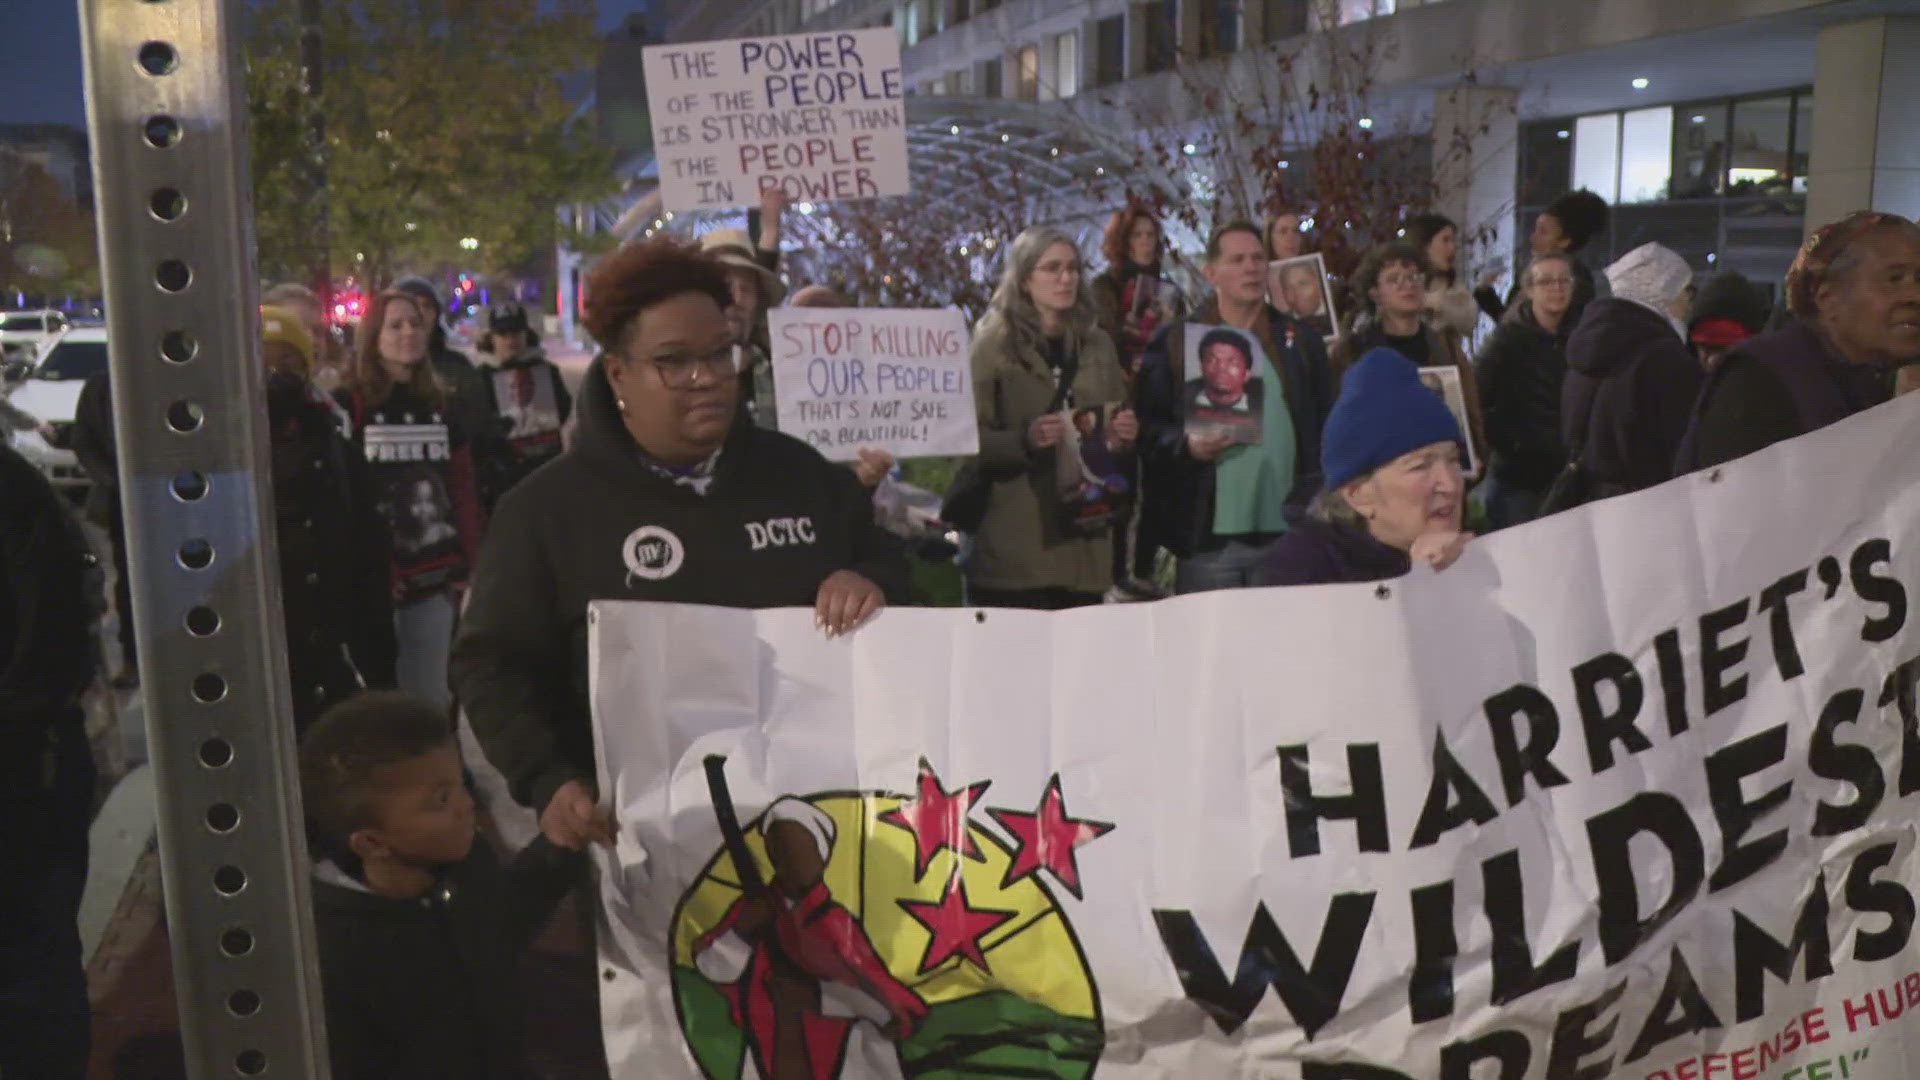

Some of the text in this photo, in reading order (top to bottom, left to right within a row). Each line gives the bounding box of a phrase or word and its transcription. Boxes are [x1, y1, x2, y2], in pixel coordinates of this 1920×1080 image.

[661, 34, 864, 79] THE POWER
[667, 68, 902, 114] OF THE PEOPLE
[660, 106, 901, 146] IS STRONGER THAN
[671, 136, 876, 178] THE PEOPLE
[696, 169, 878, 204] IN POWER
[782, 319, 961, 358] STOP KILLING
[807, 358, 964, 397] OUR PEOPLE!
[871, 400, 901, 418] NOT
[910, 400, 948, 422] SAFE
[807, 426, 928, 446] OR BEAUTIFUL!
[744, 517, 817, 550] DCTC
[1276, 538, 1907, 858] HARRIET'S
[1151, 656, 1920, 1041] WILDEST
[1301, 841, 1916, 1080] EAMS
[1842, 973, 1920, 1032] HUB
